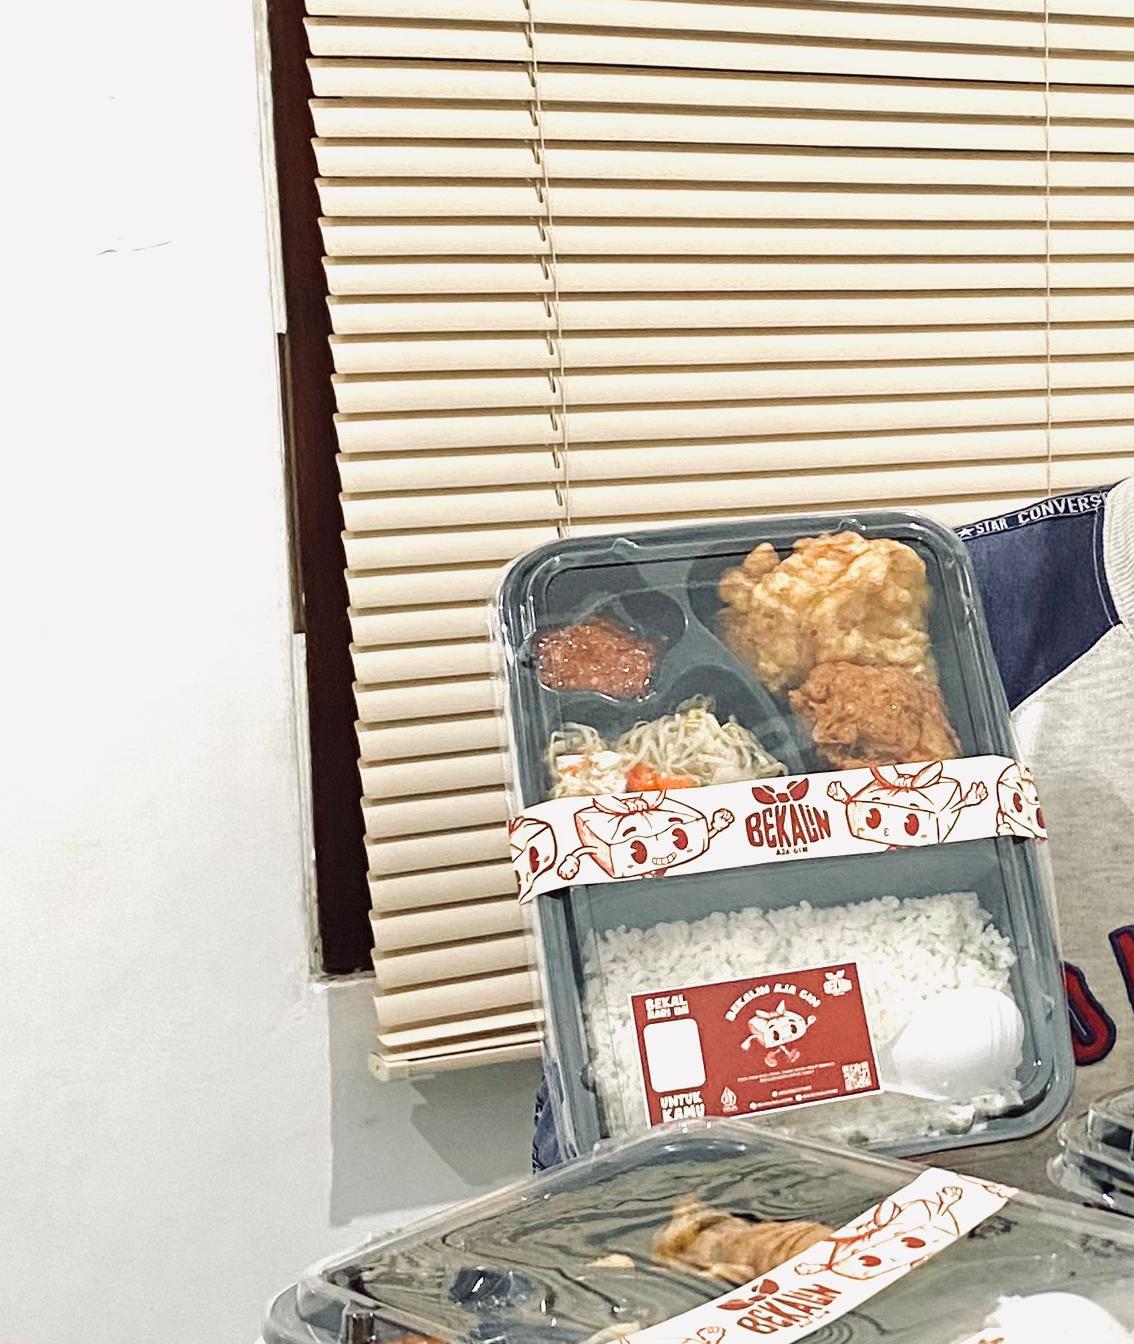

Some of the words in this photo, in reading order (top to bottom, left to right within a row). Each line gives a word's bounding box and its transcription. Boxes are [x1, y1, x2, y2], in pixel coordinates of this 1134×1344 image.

[975, 518, 1009, 535] STAR
[1017, 493, 1108, 525] CONVERS
[660, 1091, 703, 1108] UNTUK
[662, 1102, 705, 1123] KAMU
